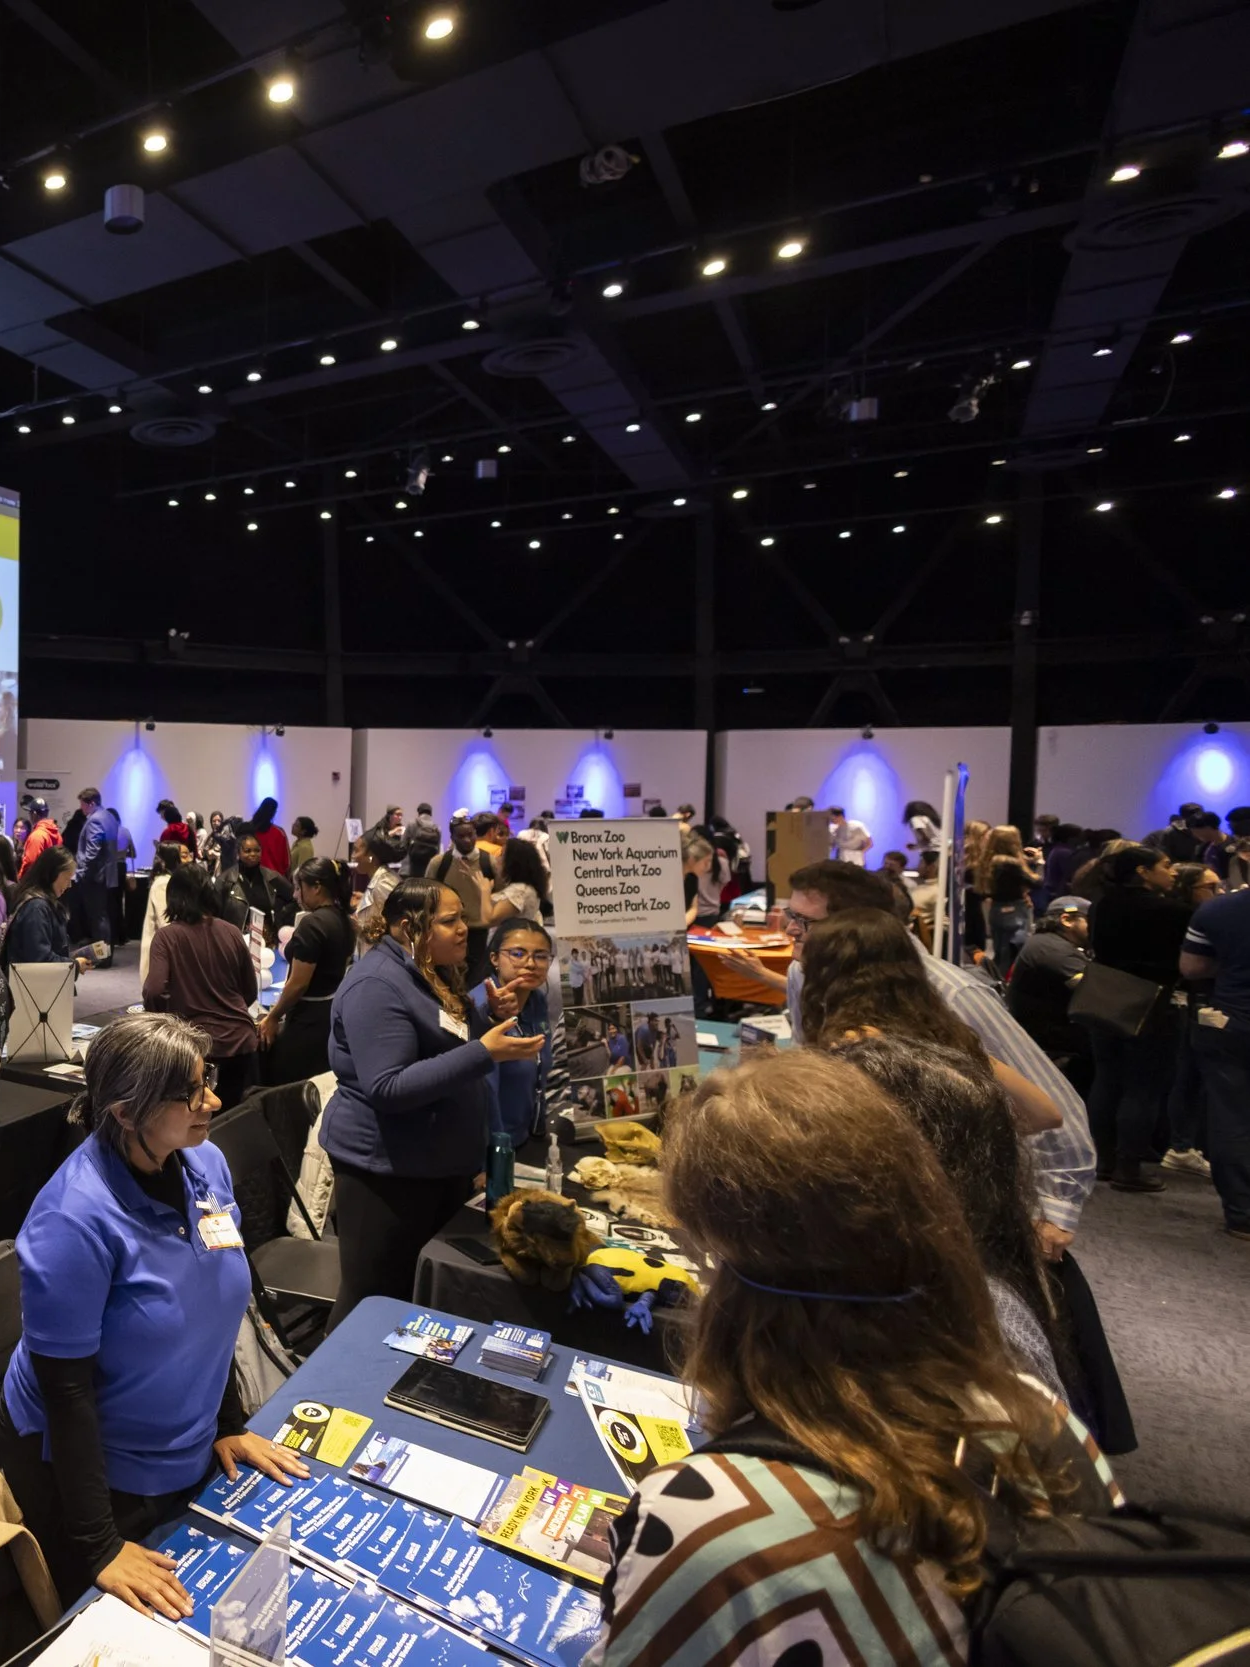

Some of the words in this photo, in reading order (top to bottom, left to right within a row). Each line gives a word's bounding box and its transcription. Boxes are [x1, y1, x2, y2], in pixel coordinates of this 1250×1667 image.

[570, 831, 603, 844] Bronx
[604, 830, 625, 843] Zoo
[572, 848, 598, 861] New
[599, 847, 624, 860] York
[626, 846, 678, 862] Aquarium
[574, 865, 614, 879] Central
[616, 864, 639, 877] Park
[641, 864, 662, 876] Zoo
[576, 883, 617, 897] Queens
[619, 882, 640, 895] Zoo
[577, 900, 623, 916] Prospect
[625, 898, 648, 912] Park
[650, 898, 671, 910] Zoo
[543, 1491, 556, 1504] MY
[500, 1519, 518, 1539] READY
[514, 1506, 528, 1518] NEW
[524, 1486, 538, 1503] YORK
[545, 1498, 571, 1536] EMERGENCY
[574, 1504, 590, 1523] PLAN
